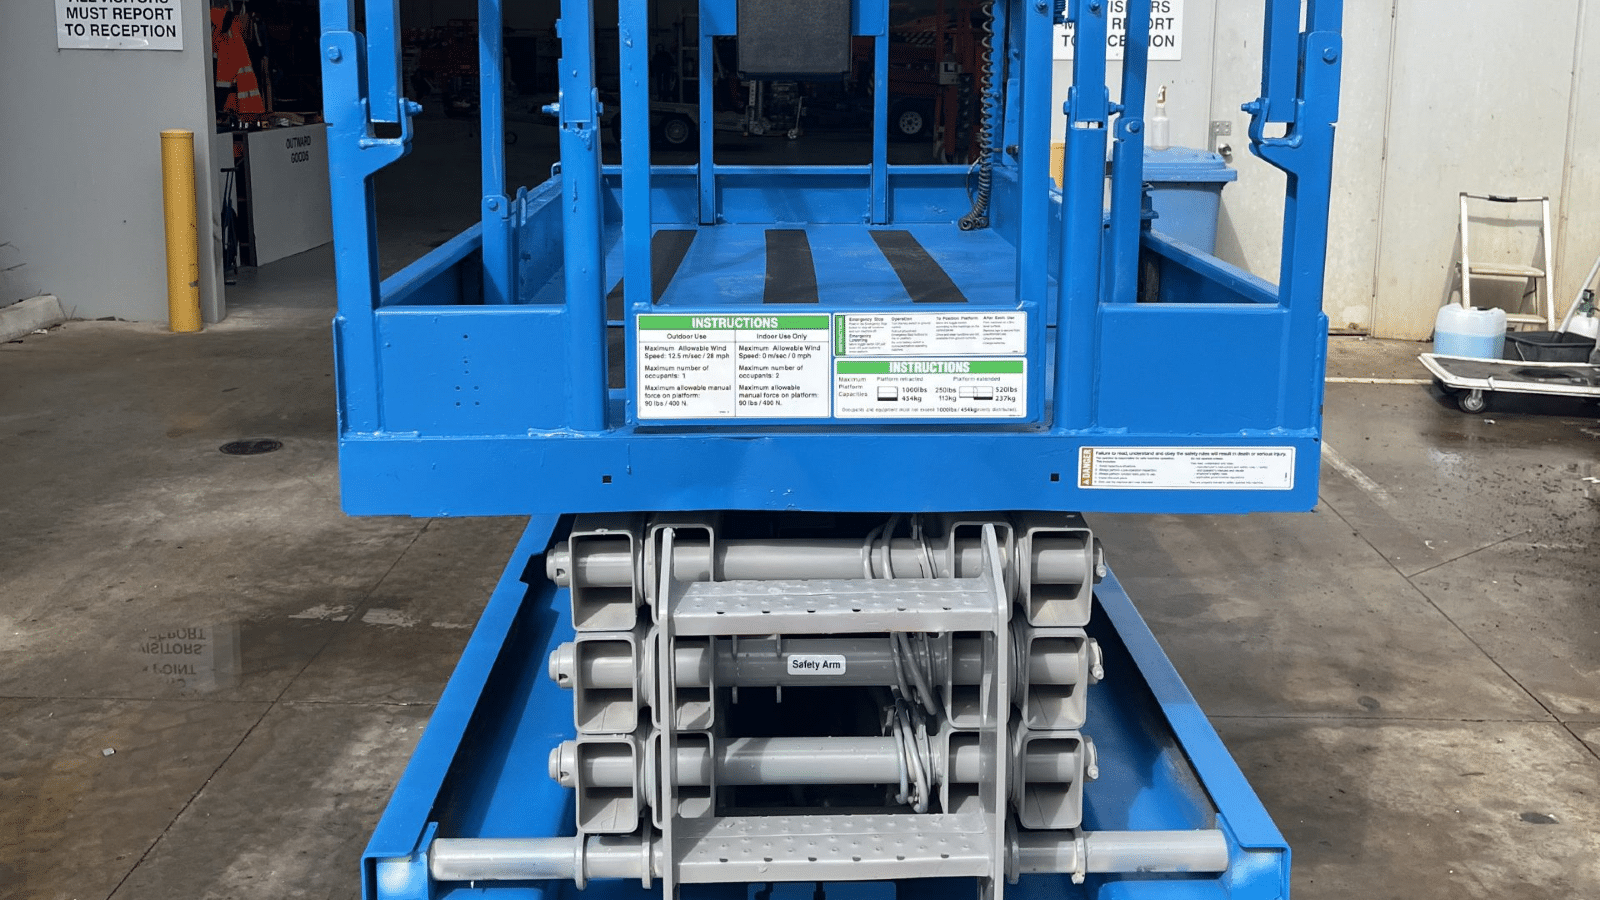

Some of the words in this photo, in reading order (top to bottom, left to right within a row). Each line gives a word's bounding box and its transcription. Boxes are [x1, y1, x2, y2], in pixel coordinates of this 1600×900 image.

[66, 7, 108, 19] MUST
[113, 8, 173, 20] REPORT
[65, 24, 85, 36] TO
[90, 24, 176, 37] RECEPTION
[286, 135, 311, 149] OUTWARD
[291, 150, 309, 164] GOODS
[691, 317, 778, 328] INSTRUCTIONS
[889, 361, 970, 373] INSTRUCTIONS
[901, 395, 922, 403] 454kg
[1083, 449, 1093, 478] DANGER
[792, 660, 820, 670] Safety
[823, 660, 841, 668] Arm
